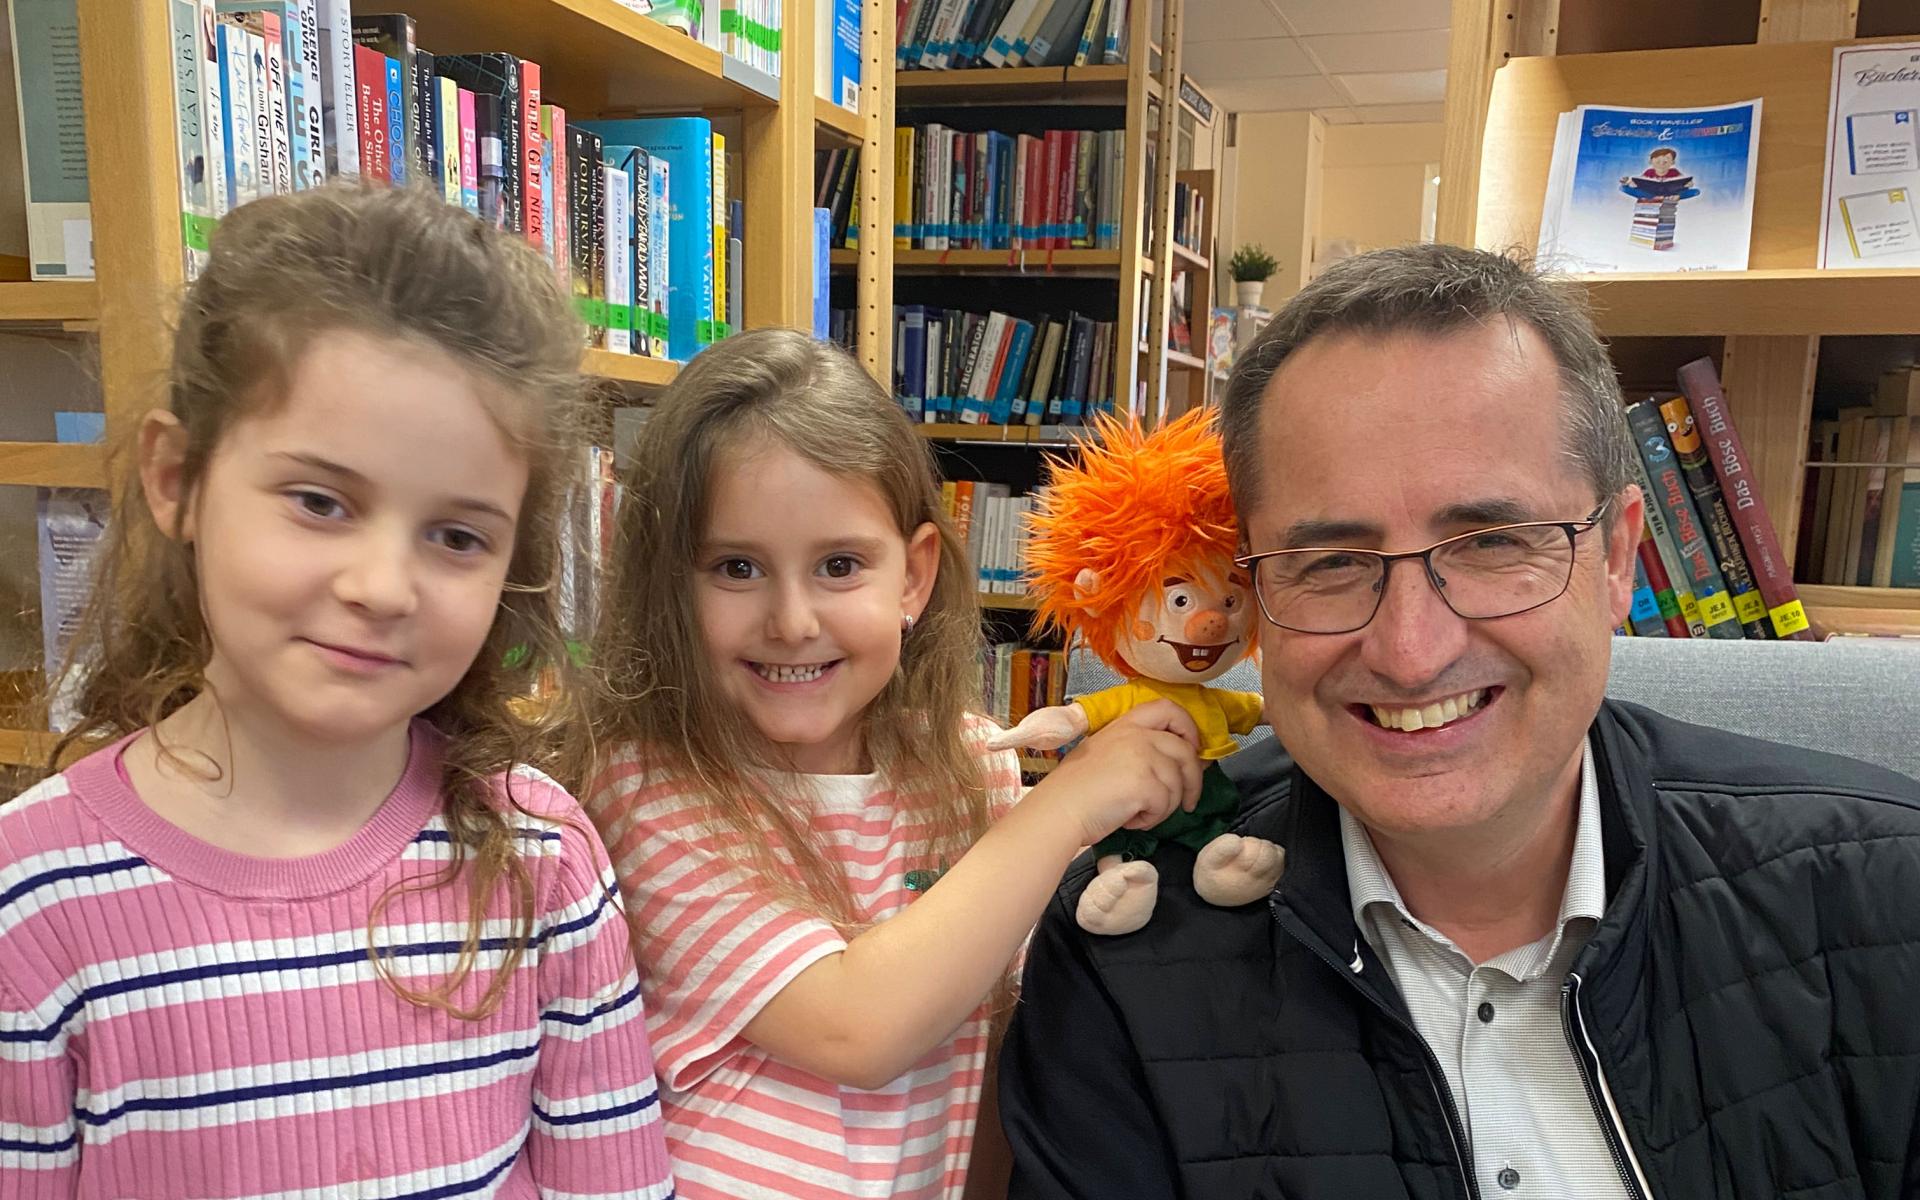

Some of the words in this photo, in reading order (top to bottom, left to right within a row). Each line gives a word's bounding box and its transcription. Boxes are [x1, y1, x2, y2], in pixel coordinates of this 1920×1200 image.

[300, 10, 310, 62] GIVEN
[182, 32, 199, 137] GATSBY
[270, 56, 283, 92] OFF
[340, 17, 355, 132] STORYTELLER
[410, 64, 418, 97] THE
[256, 87, 266, 112] John
[274, 100, 285, 132] THE
[362, 84, 374, 135] Bennet
[372, 98, 383, 124] The
[424, 91, 432, 140] Midnight
[510, 98, 518, 117] The
[528, 88, 540, 143] Funny
[310, 106, 322, 164] GIRL
[412, 102, 421, 141] GIRL
[256, 114, 272, 186] Grisham
[365, 140, 374, 178] Siste
[374, 130, 384, 174] Other
[464, 128, 476, 188] Beach
[510, 118, 520, 167] Library
[276, 140, 291, 194] RECOR
[512, 168, 520, 181] of
[528, 149, 542, 190] Girl
[580, 156, 590, 206] JOHN
[513, 182, 521, 197] the
[513, 199, 522, 232] Dead
[530, 195, 542, 236] NICK
[581, 212, 590, 278] IRVING
[638, 263, 649, 303] MAN
[702, 263, 711, 322] VANITY
[1700, 395, 1726, 437] Buch
[1644, 436, 1671, 464] 3
[1717, 436, 1744, 476] Böse
[1660, 468, 1685, 508] Buch
[1731, 478, 1756, 511] Das
[1674, 503, 1701, 545] Böse
[1690, 552, 1714, 582] Das
